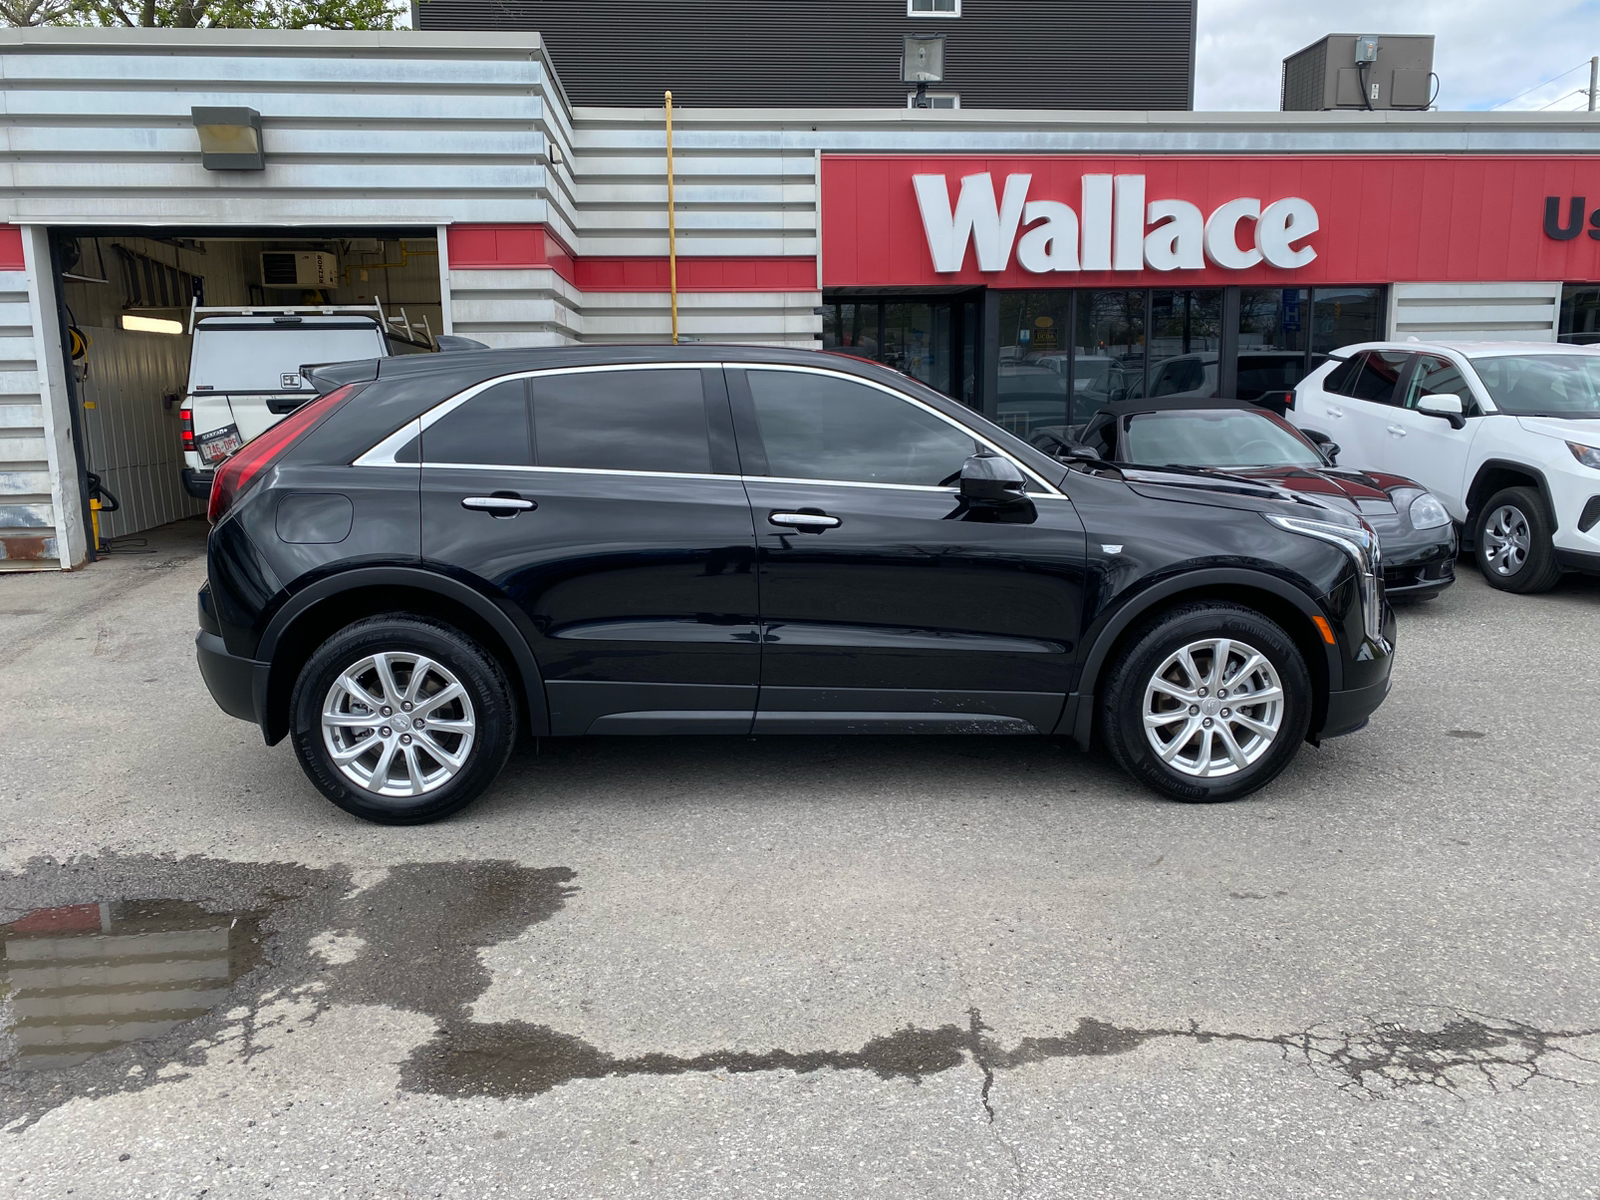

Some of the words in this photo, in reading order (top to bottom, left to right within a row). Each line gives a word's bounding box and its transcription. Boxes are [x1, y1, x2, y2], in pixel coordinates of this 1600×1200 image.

[912, 172, 1320, 273] Wallace
[1228, 618, 1282, 651] Continental
[451, 654, 494, 706] Continental
